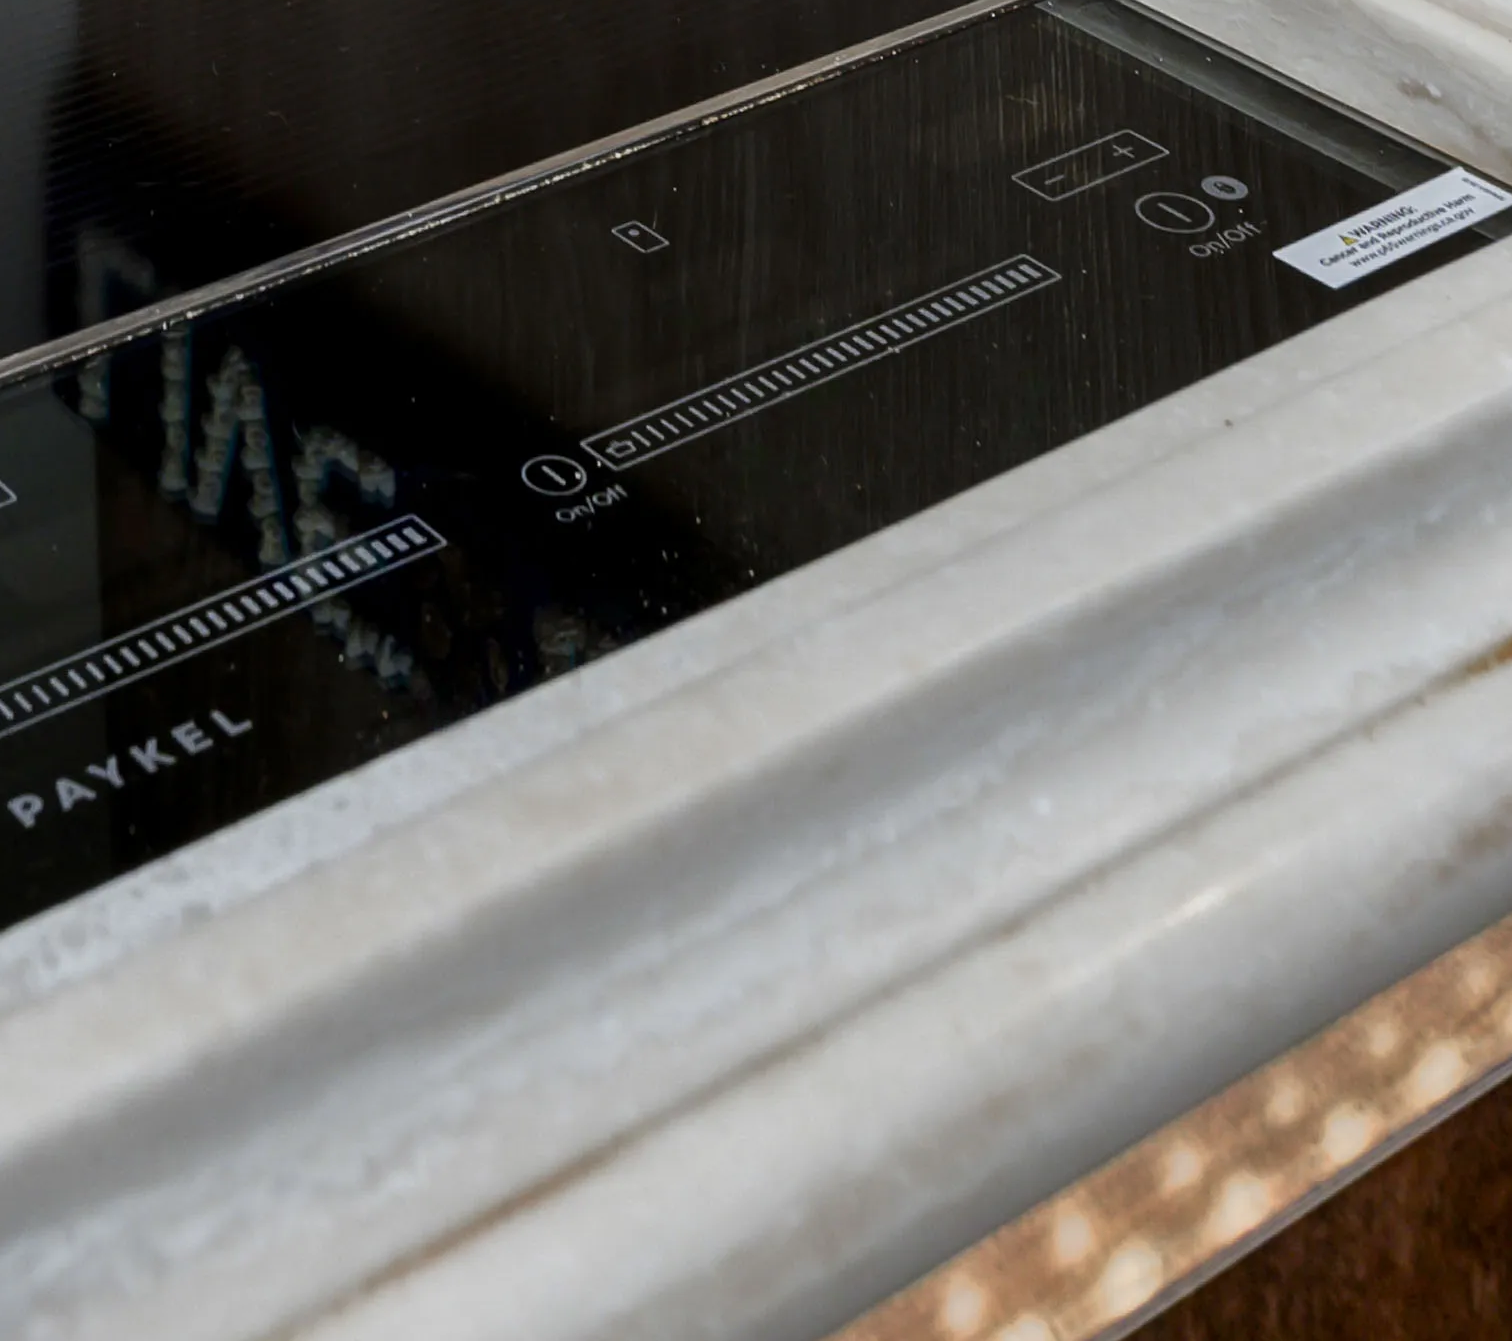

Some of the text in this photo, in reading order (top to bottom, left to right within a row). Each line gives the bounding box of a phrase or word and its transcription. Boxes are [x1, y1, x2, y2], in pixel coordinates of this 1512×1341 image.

[1189, 221, 1261, 258] On/Off
[1350, 204, 1418, 239] WARNING:
[555, 484, 628, 523] On/Off
[7, 708, 253, 829] PAYKEL
